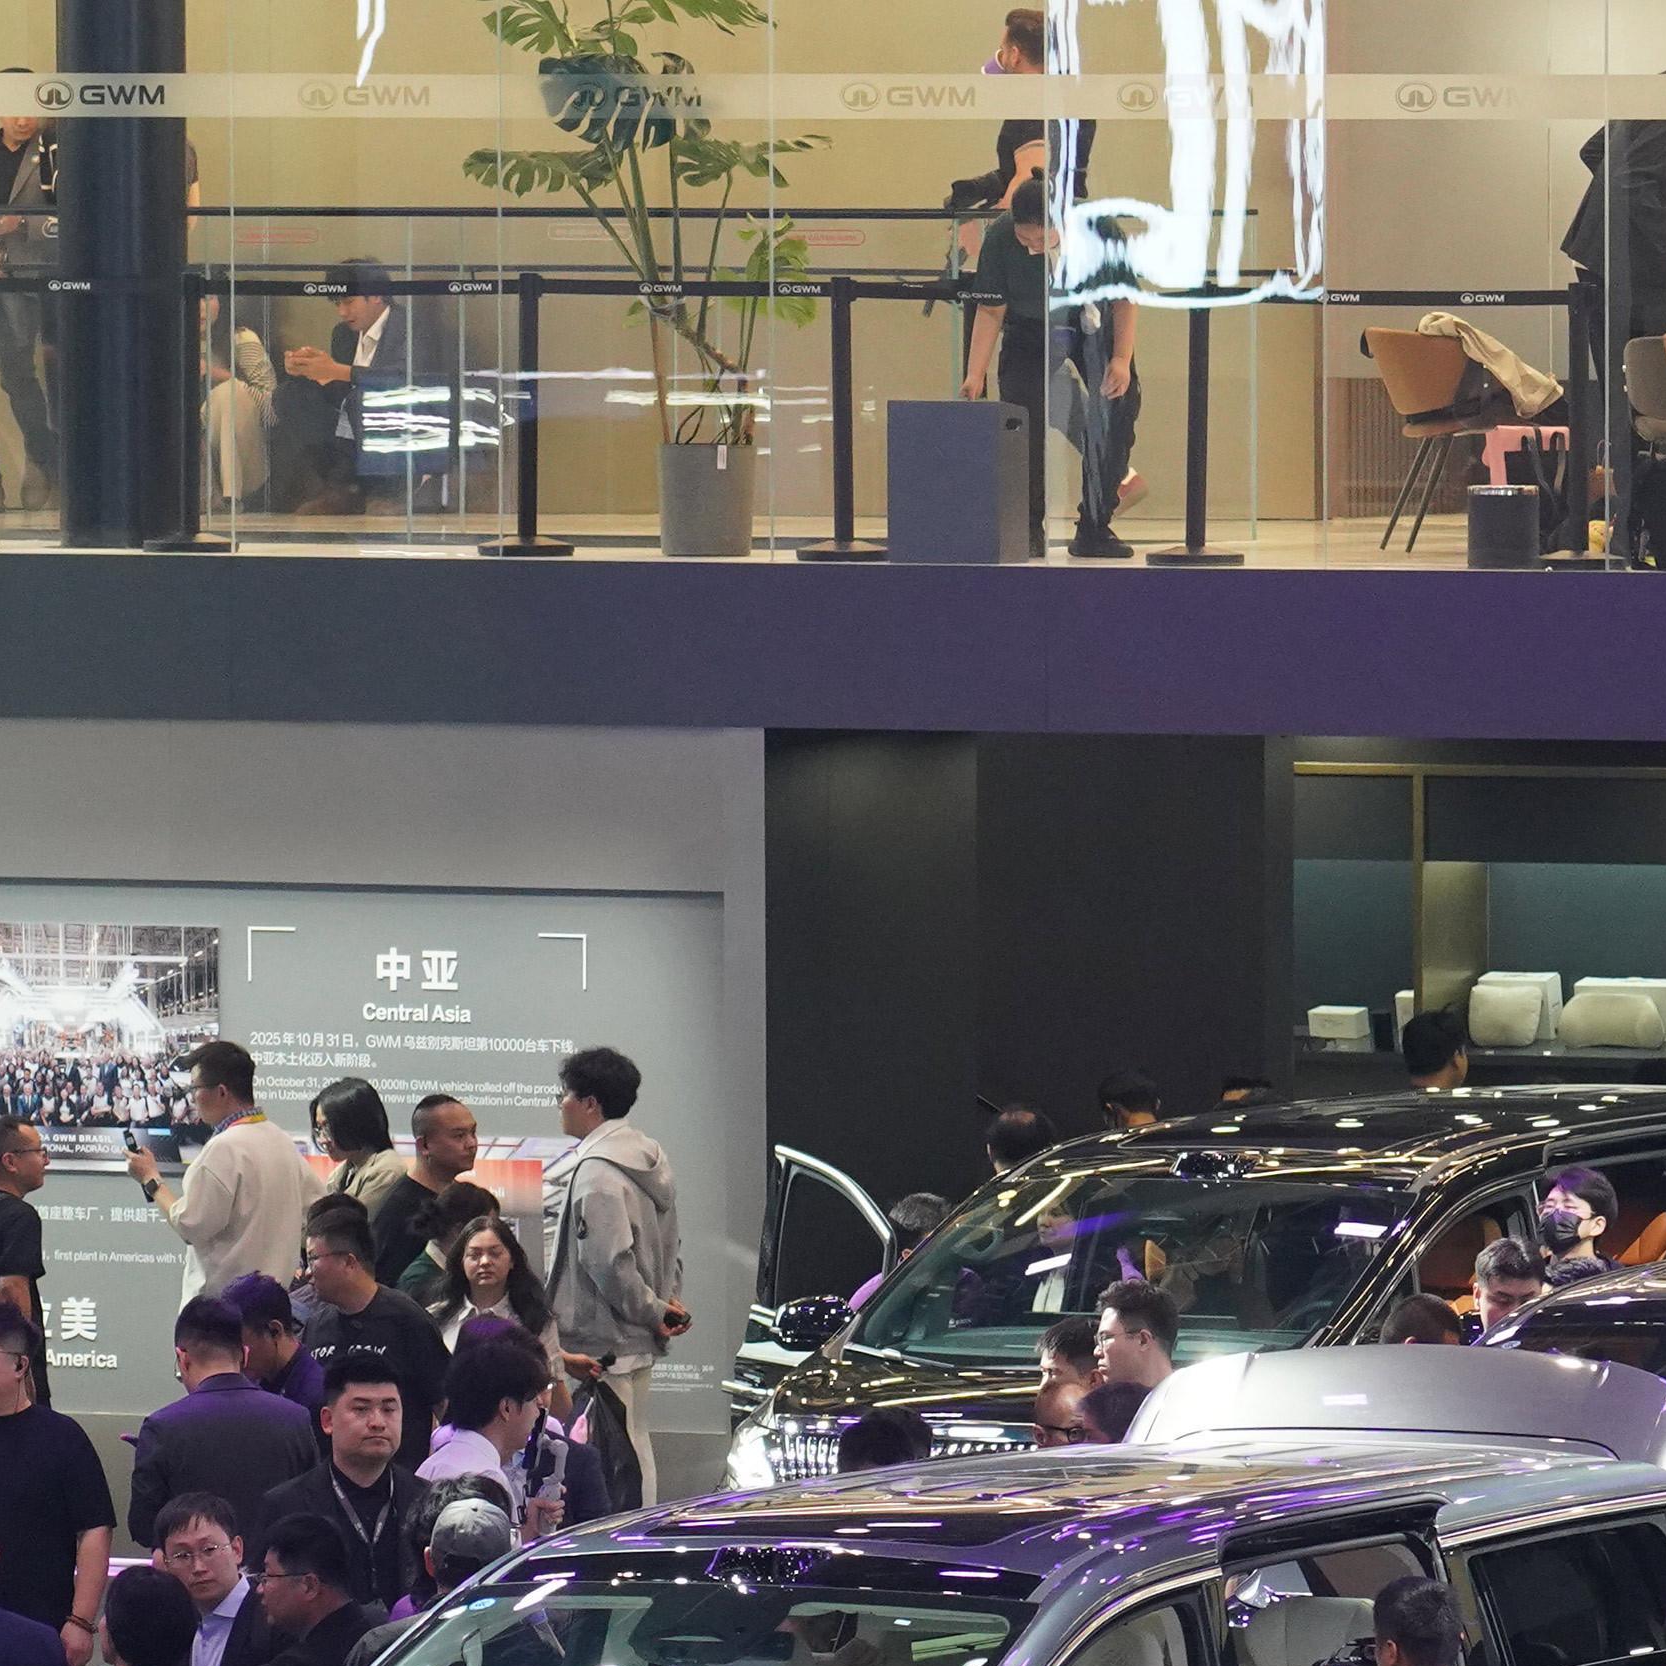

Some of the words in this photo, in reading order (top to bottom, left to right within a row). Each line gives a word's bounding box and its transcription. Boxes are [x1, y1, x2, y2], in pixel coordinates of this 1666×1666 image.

[79, 85, 163, 106] GWM
[343, 86, 430, 106] GWM
[613, 86, 702, 107] GWM
[886, 86, 975, 107] GWM
[61, 281, 91, 291] GWM
[318, 283, 347, 293] GWM
[462, 282, 493, 292] GWM
[653, 283, 683, 293] GWM
[791, 283, 821, 293] GWM
[1331, 293, 1361, 303] GWM
[1474, 293, 1505, 304] GWM
[375, 946, 459, 992] 中亚
[362, 1002, 429, 1022] Central
[431, 1003, 472, 1023] Asia
[266, 1076, 306, 1088] October
[410, 1079, 438, 1090] GWM
[52, 1134, 77, 1142] GWM
[78, 1134, 114, 1143] BRASIL
[73, 1251, 98, 1264] plant
[107, 1252, 156, 1264] Americas
[156, 1253, 176, 1264] with
[45, 1347, 118, 1370] America
